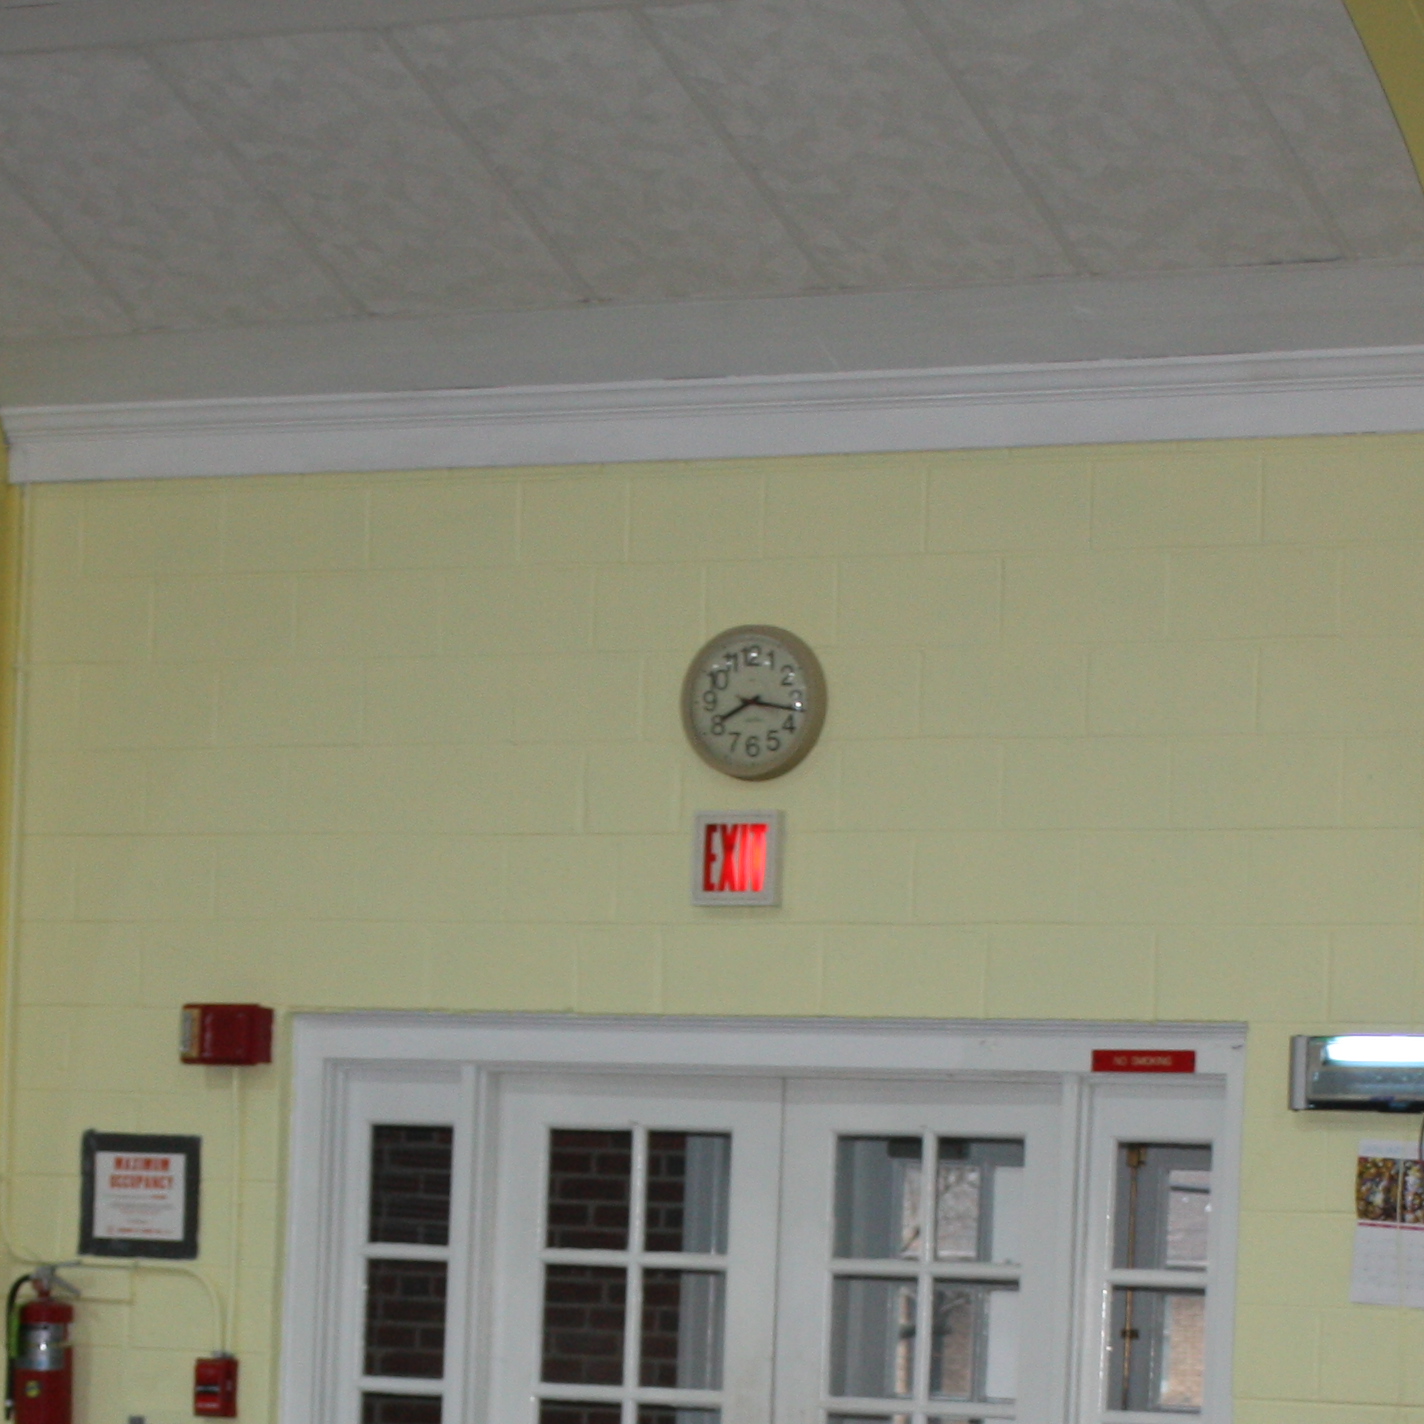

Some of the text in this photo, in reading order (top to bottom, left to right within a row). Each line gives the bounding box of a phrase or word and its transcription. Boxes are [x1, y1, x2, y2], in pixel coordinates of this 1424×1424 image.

[741, 645, 761, 667] 12
[767, 650, 775, 670] 1
[707, 669, 728, 690] 10
[780, 665, 794, 686] 2
[703, 690, 716, 712] 9
[711, 714, 725, 736] 8
[782, 714, 796, 734] 4
[728, 732, 742, 752] 7
[745, 736, 760, 758] 6
[767, 730, 780, 751] 5
[703, 823, 769, 892] EXIT
[113, 1157, 171, 1172] MAXIMUM
[109, 1174, 174, 1190] OCCUPANCY
